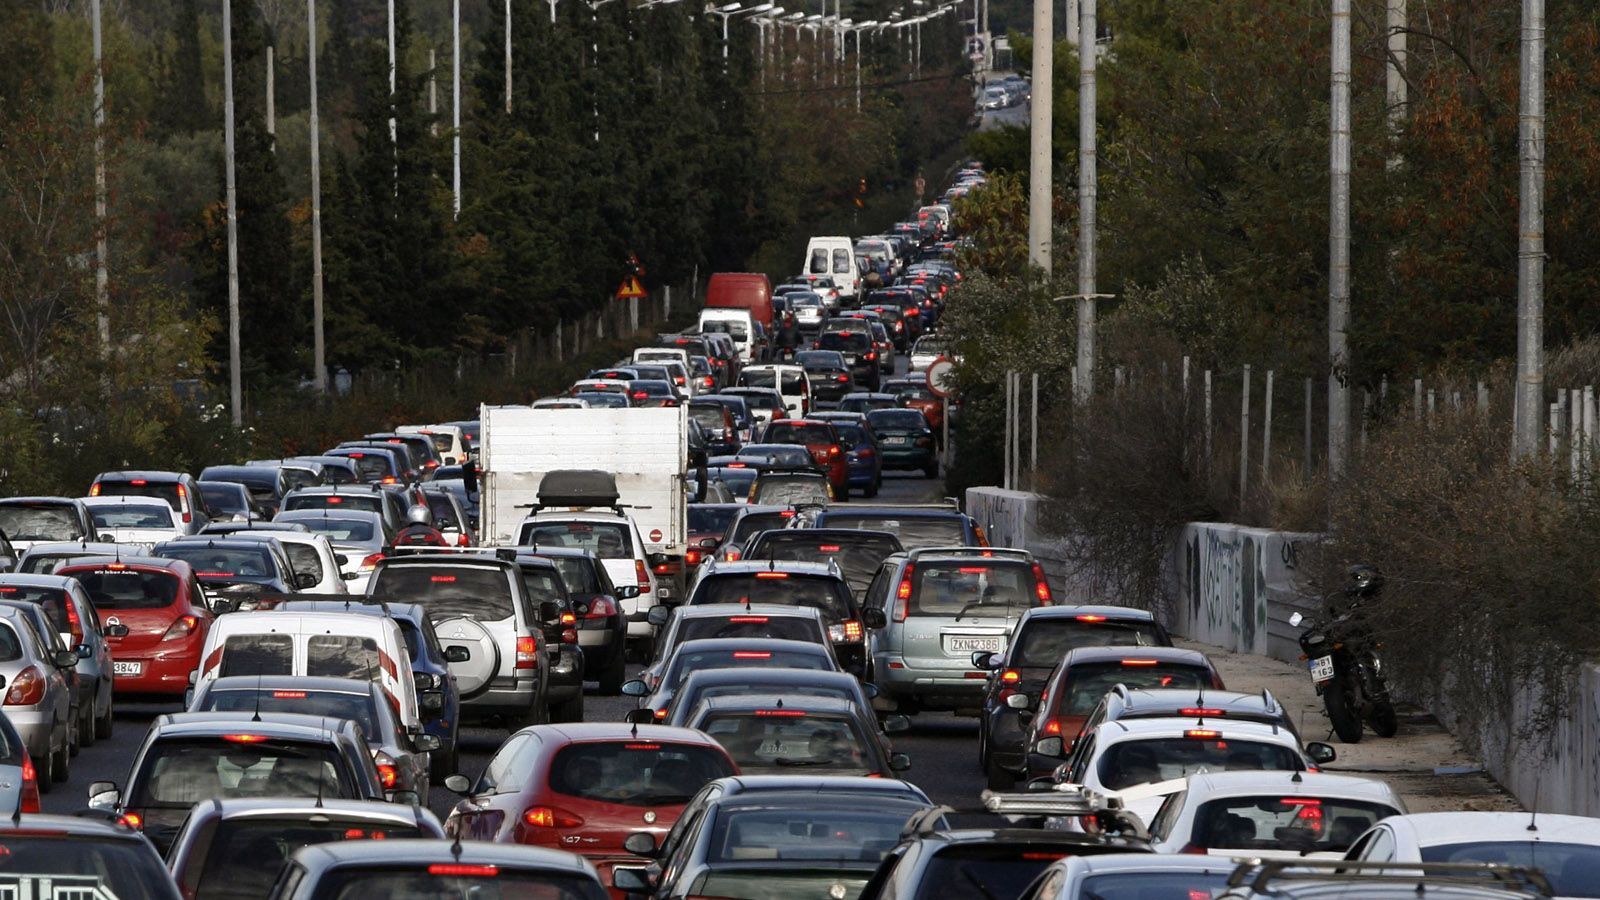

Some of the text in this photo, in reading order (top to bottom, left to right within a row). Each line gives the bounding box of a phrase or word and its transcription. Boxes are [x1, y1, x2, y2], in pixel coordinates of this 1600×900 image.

[953, 639, 998, 650] ZKN 2386
[114, 663, 139, 673] 3847
